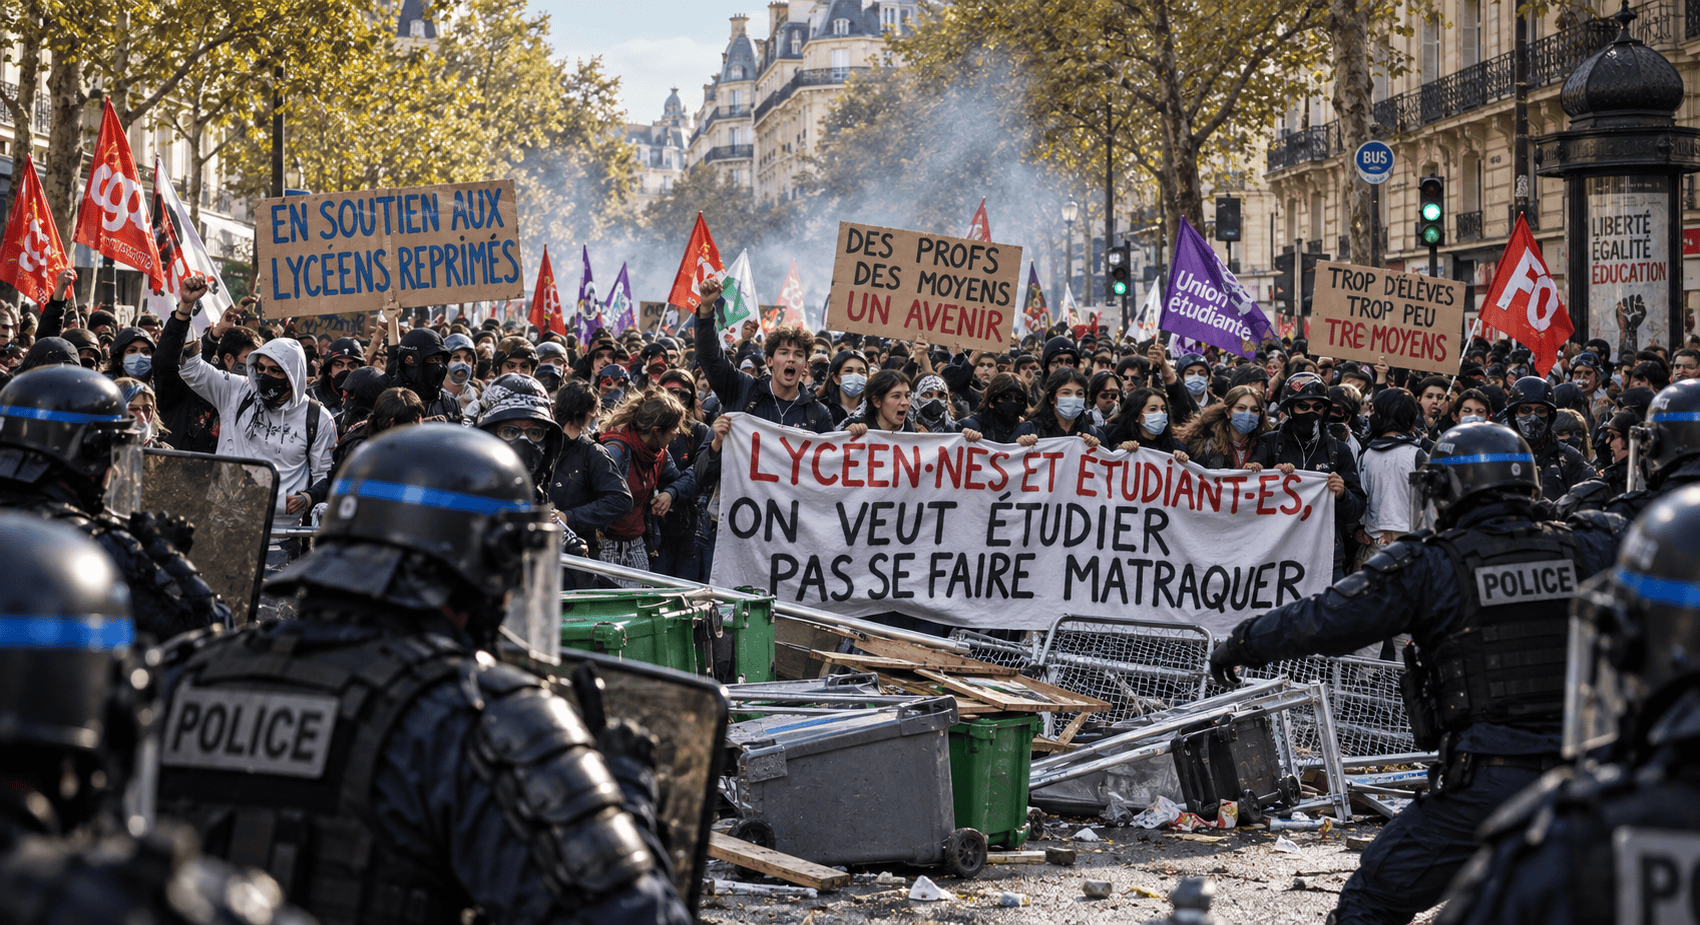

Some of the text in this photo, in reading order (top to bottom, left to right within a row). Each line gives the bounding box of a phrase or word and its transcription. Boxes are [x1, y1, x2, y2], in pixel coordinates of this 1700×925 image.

[1363, 151, 1387, 164] BUS
[271, 188, 504, 244] EN SOUTIEN AUX
[1592, 209, 1651, 237] LIBERTÉ
[272, 232, 519, 301] LYCÉENS REPRIMÉS
[846, 228, 1000, 275] DES PROFS
[1592, 235, 1651, 261] ÉGALITÉ
[854, 261, 1010, 307] DES MOYENS
[1176, 270, 1228, 308] Union
[1328, 267, 1455, 306] TROP D'ÉLÈVES
[1592, 261, 1666, 285] ÉDUCATION
[847, 291, 891, 325] UN
[904, 299, 1003, 343] AVENIR
[1347, 295, 1436, 328] TROP PEU
[1370, 324, 1447, 362] MOYENS
[1021, 452, 1064, 493] ET
[728, 491, 1170, 556] ON VEUT ÉTUDIER
[770, 552, 1305, 614] PAS SE FAIRE MATRAQUER
[1482, 566, 1574, 600] POLICE
[173, 702, 323, 763] POLICE
